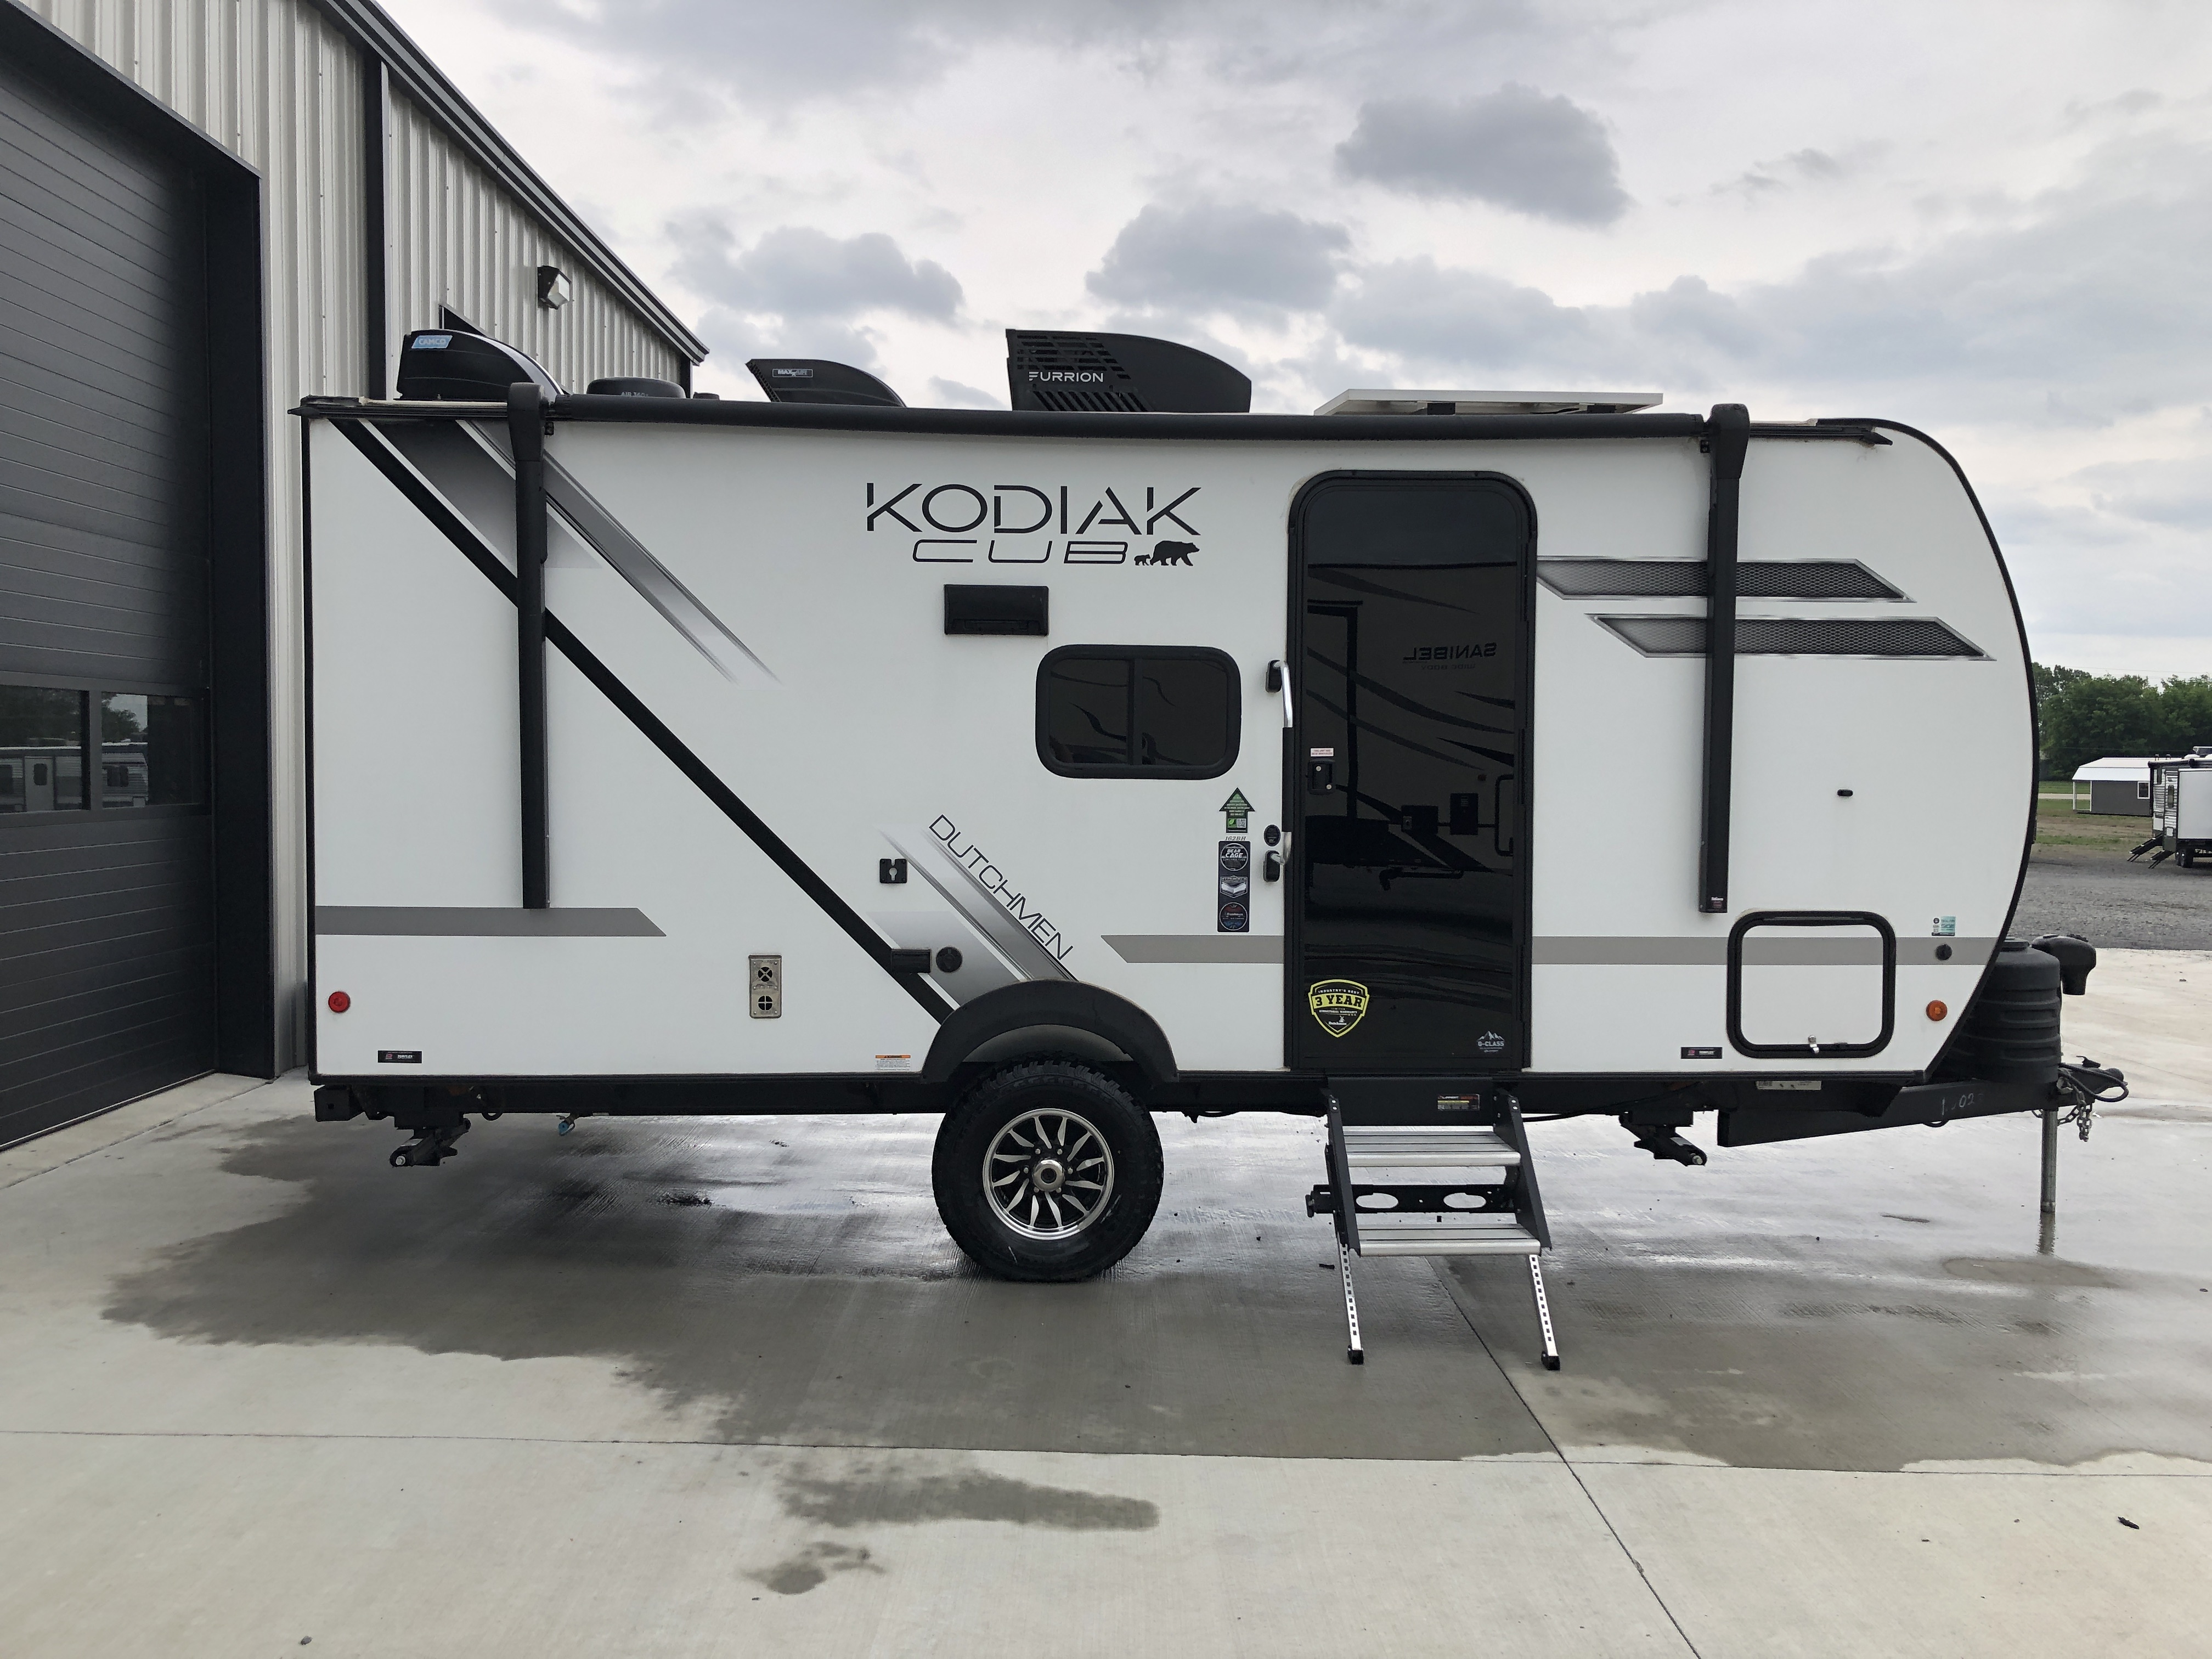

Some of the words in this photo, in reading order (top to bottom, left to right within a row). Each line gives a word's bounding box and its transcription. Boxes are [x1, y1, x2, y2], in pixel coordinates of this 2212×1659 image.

[1029, 371, 1104, 382] FURRION
[866, 482, 1202, 536] KODIAK
[912, 539, 1128, 564] CUB
[929, 814, 1074, 960] DUTCHMEN
[1315, 996, 1323, 1007] 3
[1326, 995, 1362, 1008] YEAR
